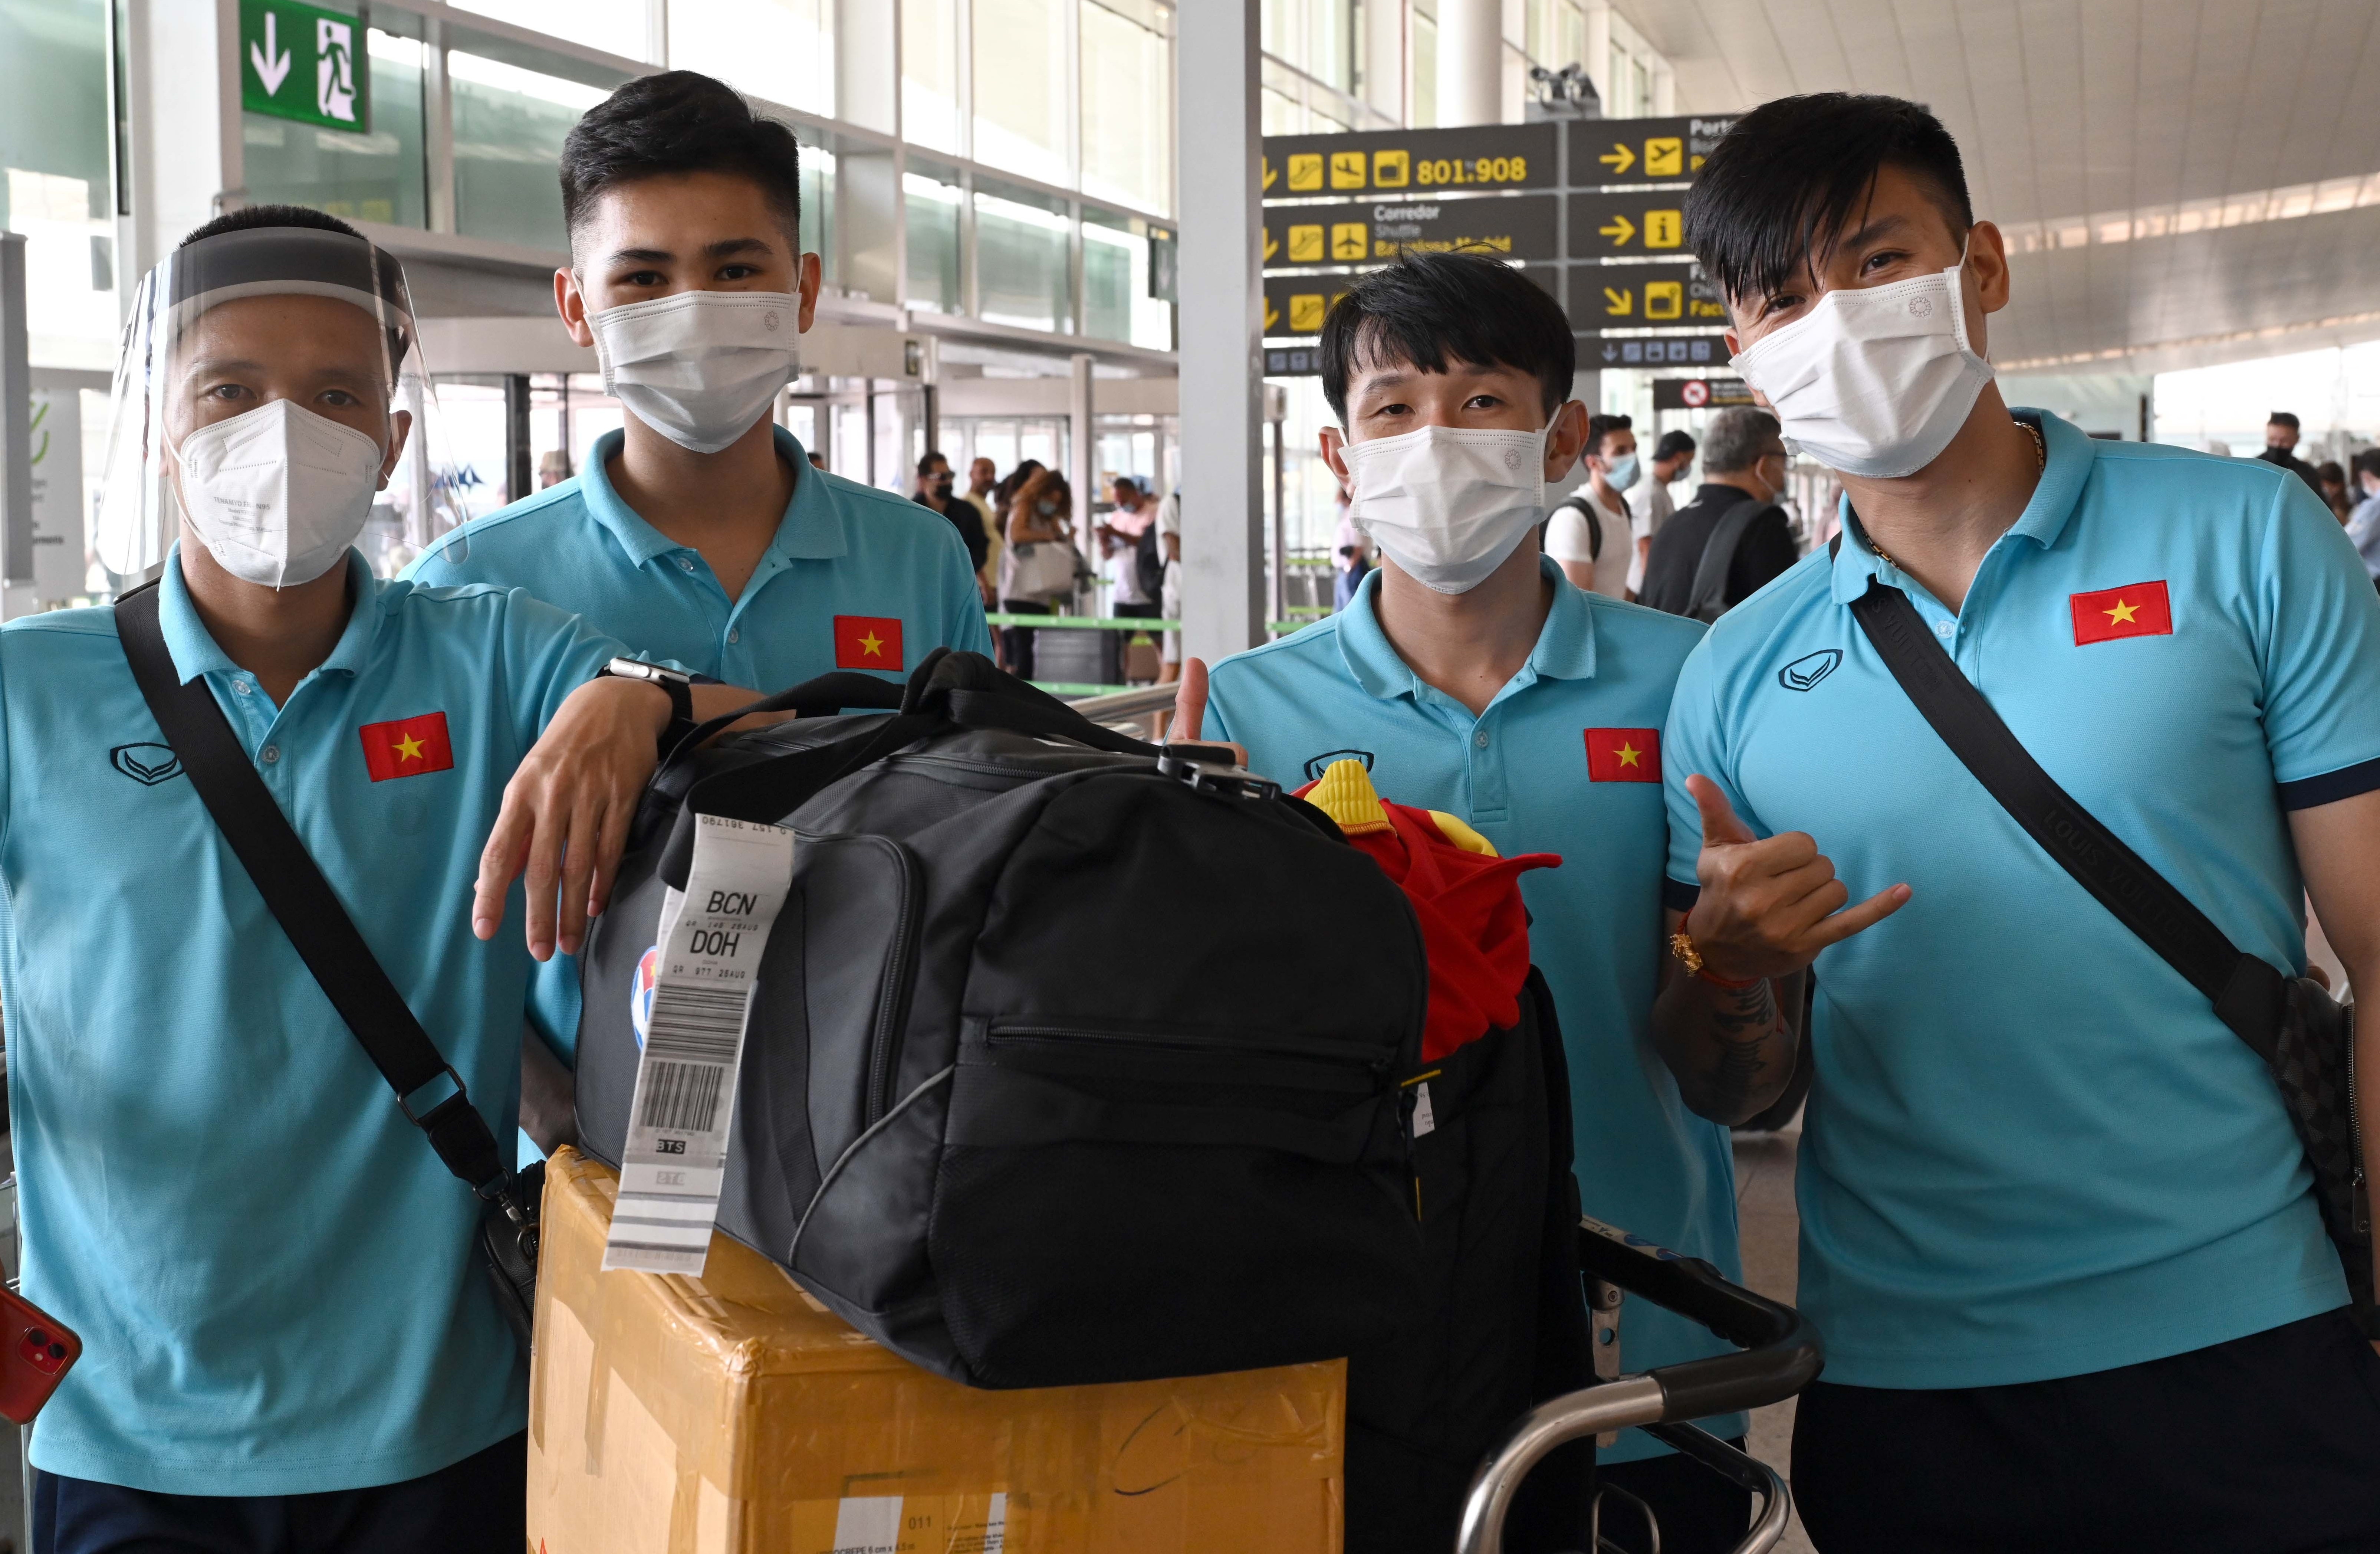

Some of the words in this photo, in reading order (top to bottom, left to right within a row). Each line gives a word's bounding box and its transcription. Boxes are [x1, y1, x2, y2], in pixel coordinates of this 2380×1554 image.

[1417, 159, 1465, 185] 801
[1475, 156, 1527, 182] 908
[1374, 204, 1441, 221] Corredor
[706, 890, 757, 916] BCN
[690, 930, 740, 957] DOH
[658, 1140, 684, 1153] BTS
[908, 1516, 931, 1529] 011
